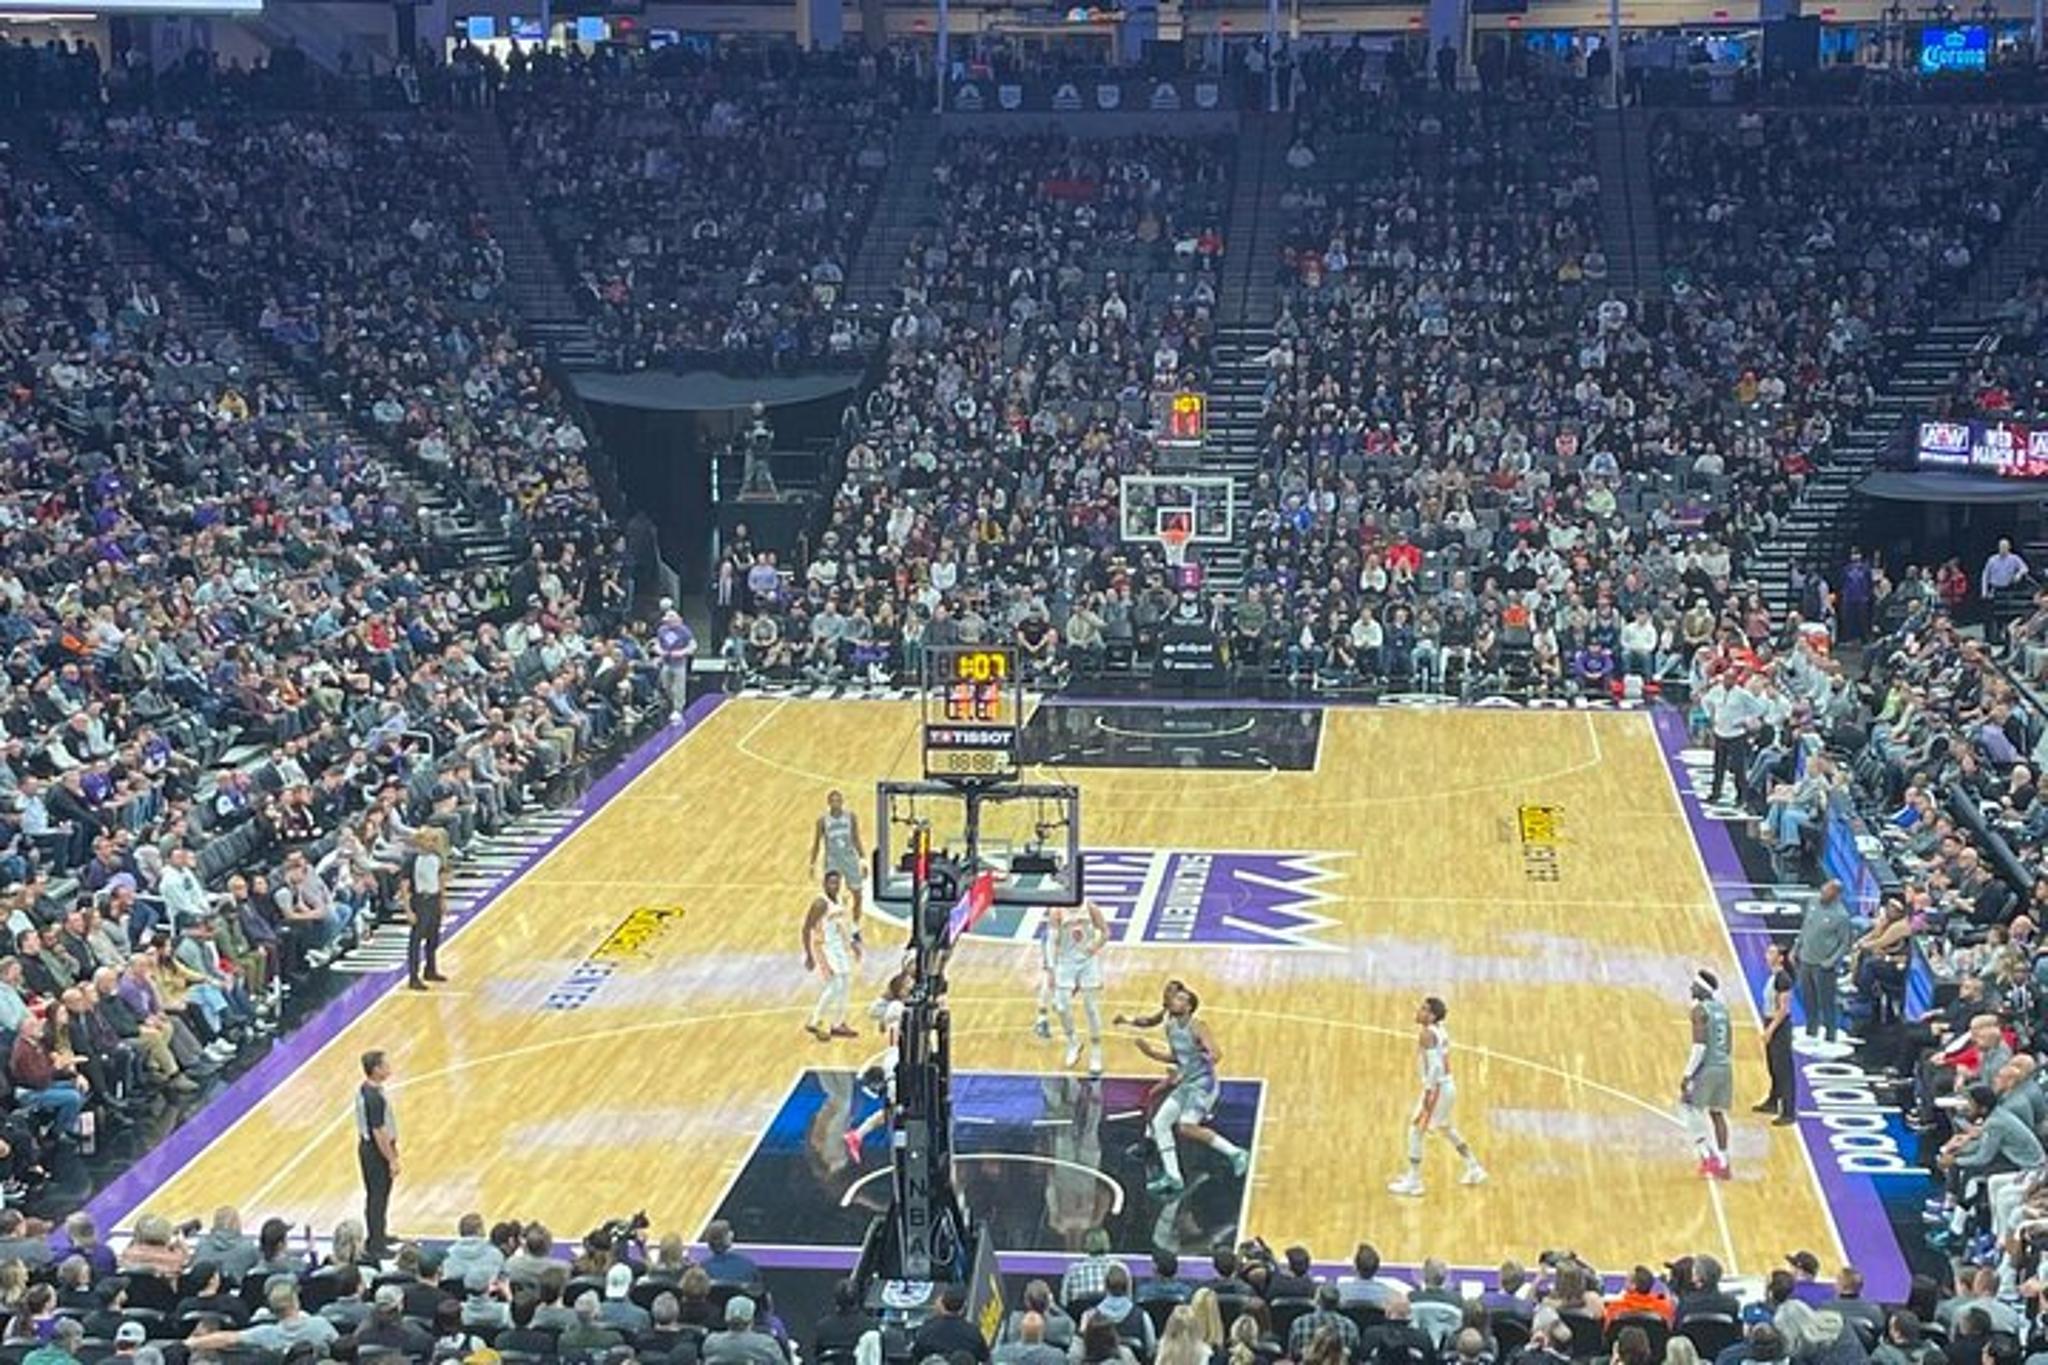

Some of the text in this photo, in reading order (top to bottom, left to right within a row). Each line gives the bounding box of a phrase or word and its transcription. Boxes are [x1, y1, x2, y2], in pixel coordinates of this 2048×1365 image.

[1922, 44, 1986, 69] Corona
[953, 730, 1013, 744] TISSOT
[1802, 1062, 1933, 1173] dialpad
